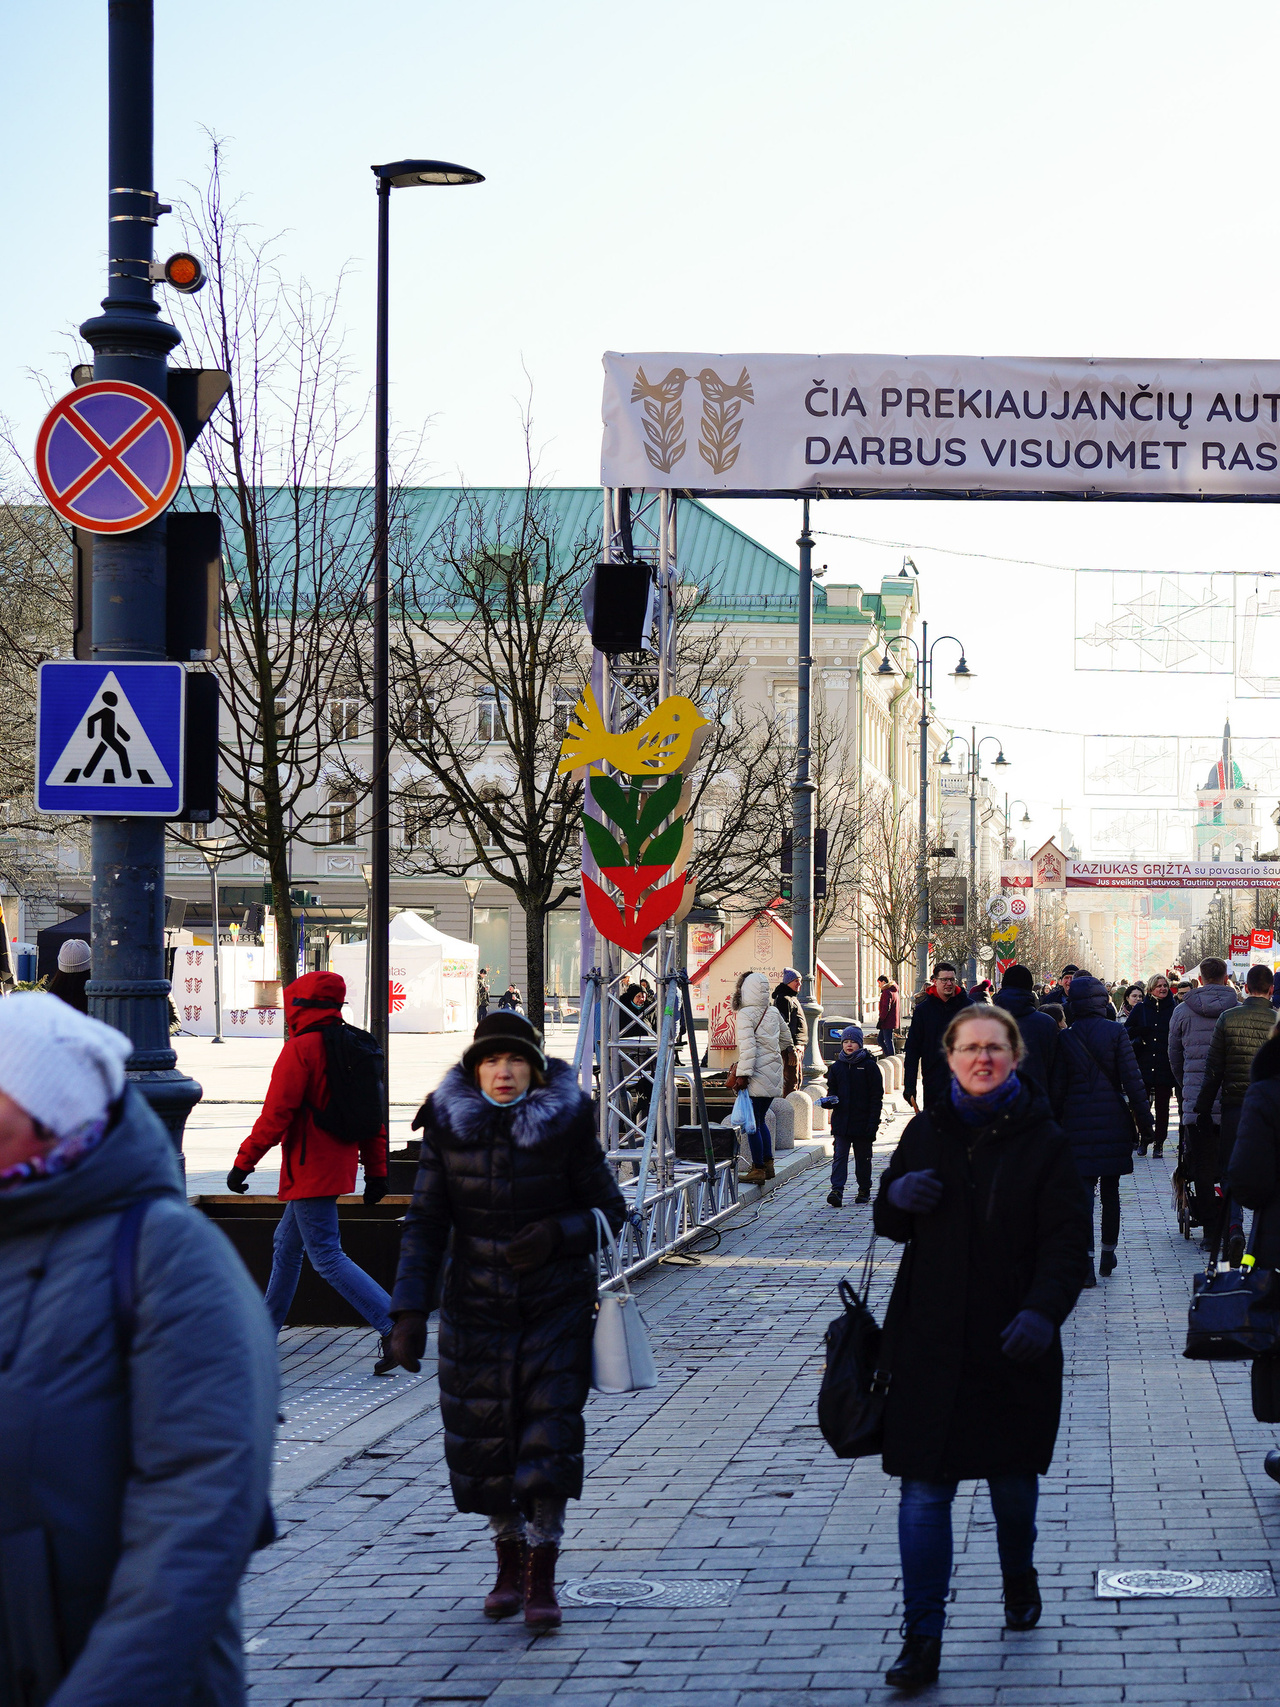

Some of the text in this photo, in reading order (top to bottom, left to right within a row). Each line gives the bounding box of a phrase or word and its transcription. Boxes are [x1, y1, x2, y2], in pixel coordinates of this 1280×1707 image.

[805, 379, 867, 417] ČIA
[881, 384, 1193, 430] PREKIAUJANČIŲ
[805, 436, 967, 466] DARBUS
[981, 438, 1187, 469] VISUOMET
[1072, 864, 1138, 875] KAZIUKAS
[1143, 862, 1191, 877] GRĮŽTA
[1194, 867, 1206, 875] su
[1209, 867, 1260, 878] pavasario
[1182, 879, 1213, 887] Tautinio
[1216, 879, 1248, 888] paveldo
